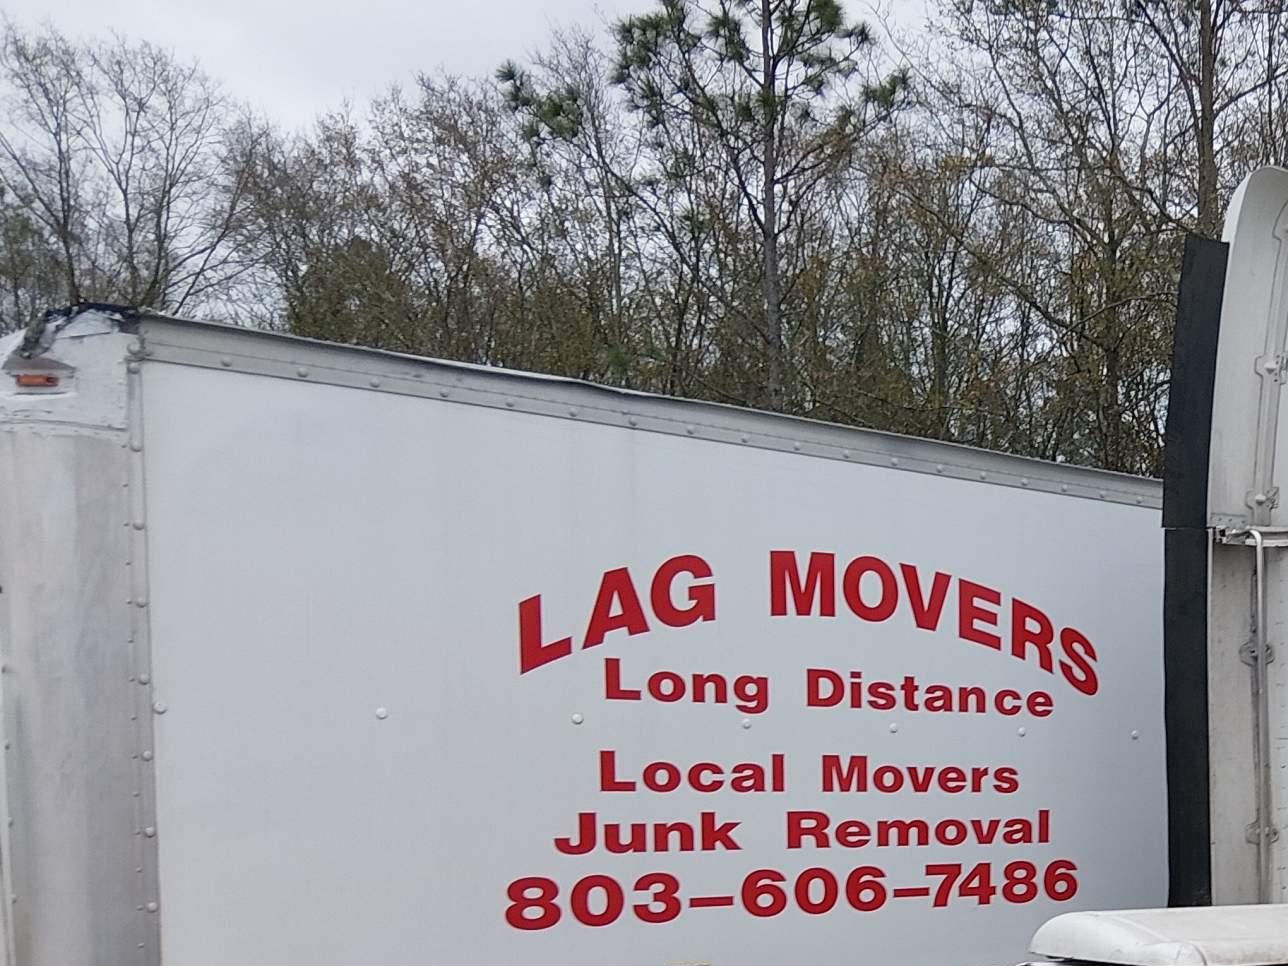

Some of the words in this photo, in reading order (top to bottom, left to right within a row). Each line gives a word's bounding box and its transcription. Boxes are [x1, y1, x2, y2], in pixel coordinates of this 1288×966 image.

[518, 554, 716, 674] LAG
[770, 550, 1099, 696] MOVERS
[604, 657, 769, 715] Long
[806, 668, 1054, 718] Distance
[599, 750, 785, 794] Local
[822, 754, 1019, 794] Movers
[554, 811, 742, 856] Junk
[786, 809, 1050, 852] Removal
[504, 859, 1078, 931] 803-606-7486
